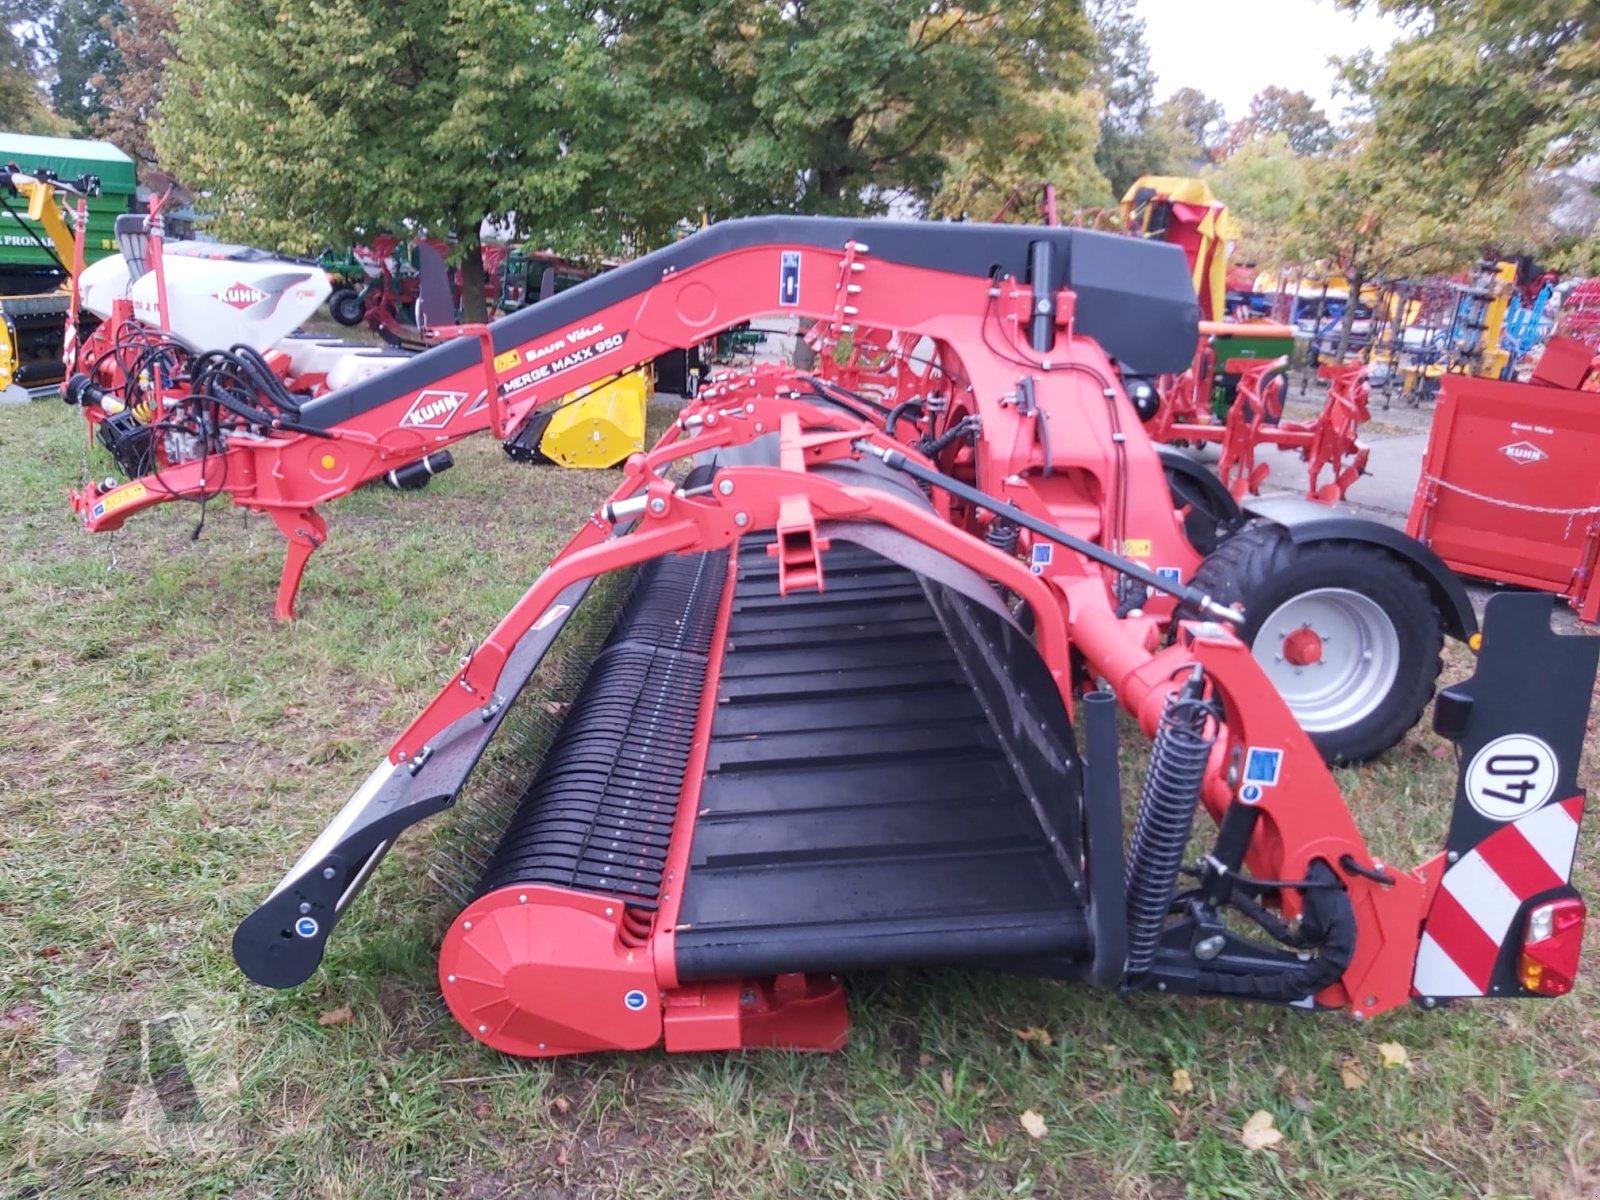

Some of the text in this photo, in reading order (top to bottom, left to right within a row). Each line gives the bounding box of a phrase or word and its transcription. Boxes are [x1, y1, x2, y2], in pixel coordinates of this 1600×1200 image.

[4, 235, 55, 247] PRONAR
[218, 287, 260, 303] KUHN
[503, 365, 551, 393] MERGE
[551, 346, 593, 372] MAXX
[595, 334, 623, 353] 950
[409, 393, 458, 426] KUHN
[1506, 447, 1540, 460] KUHN
[1482, 755, 1539, 804] 40
